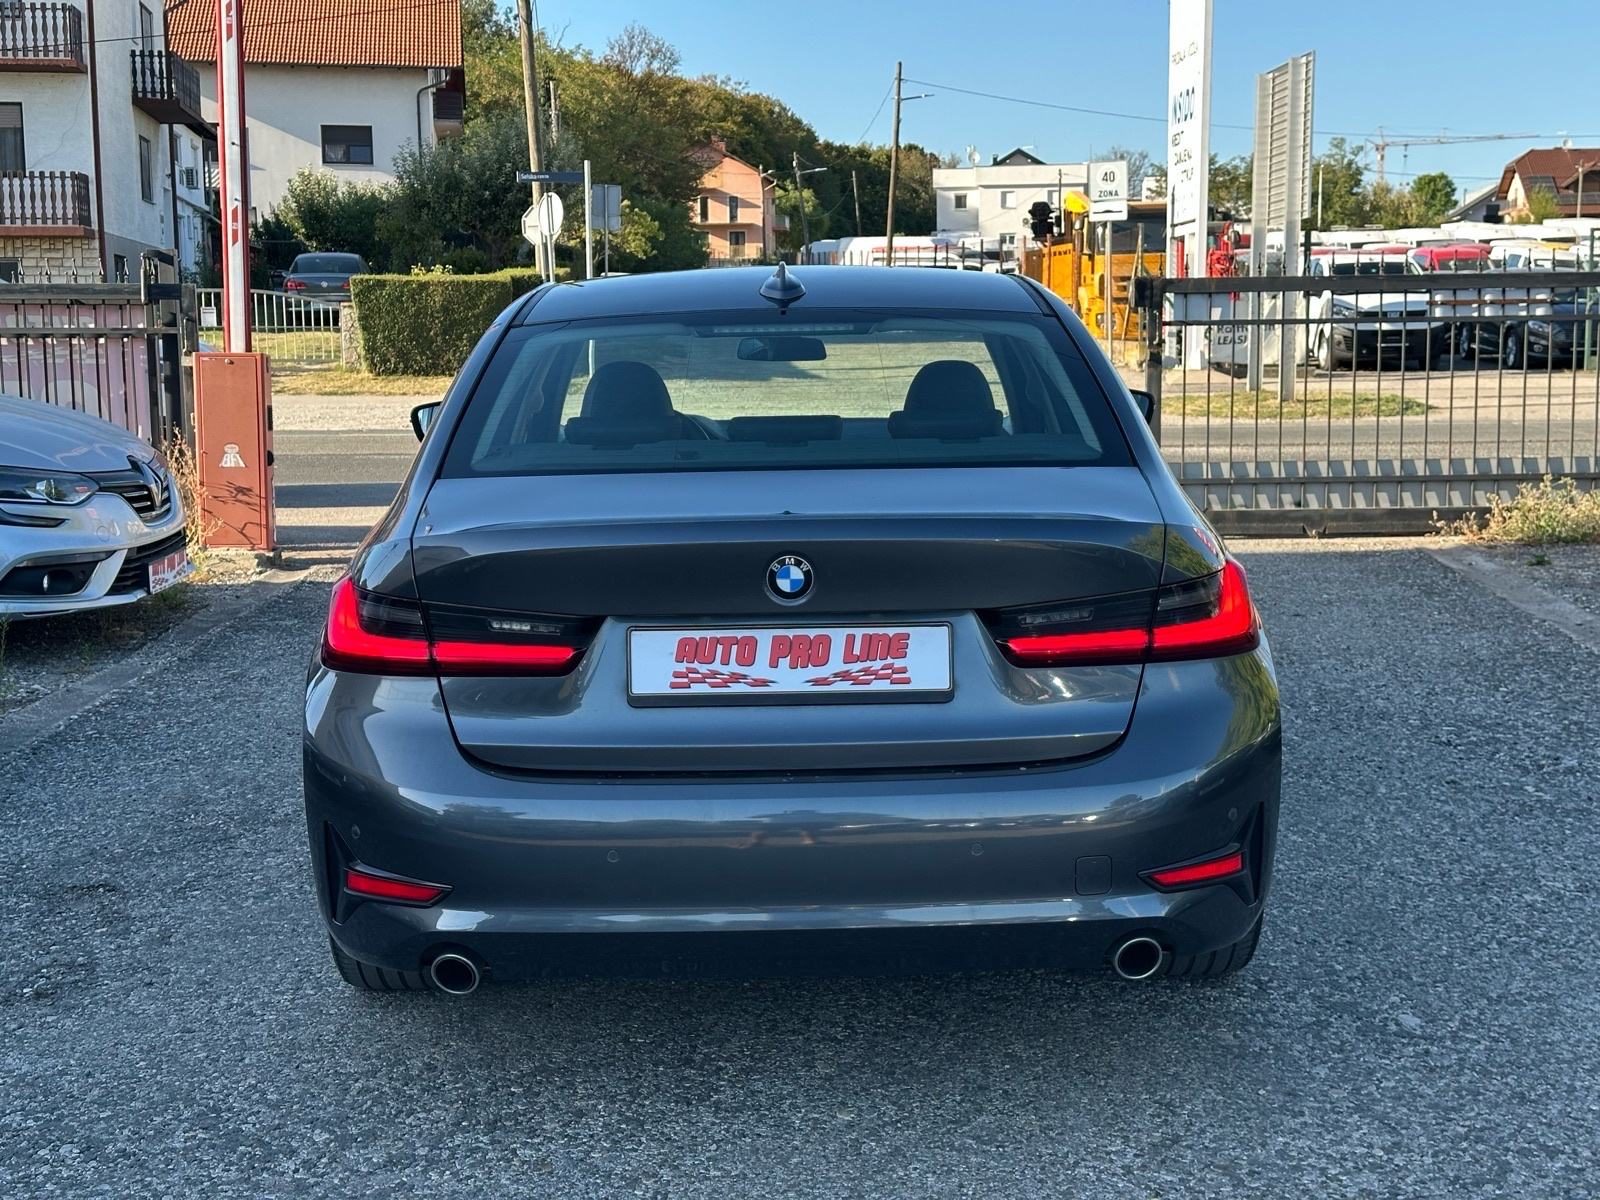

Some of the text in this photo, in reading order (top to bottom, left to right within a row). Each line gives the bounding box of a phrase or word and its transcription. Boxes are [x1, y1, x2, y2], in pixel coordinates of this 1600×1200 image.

[1102, 171, 1116, 182] 40
[1098, 190, 1119, 198] ZONA
[771, 557, 811, 573] BMW
[675, 636, 758, 667] AUTO
[769, 634, 832, 669] PRO
